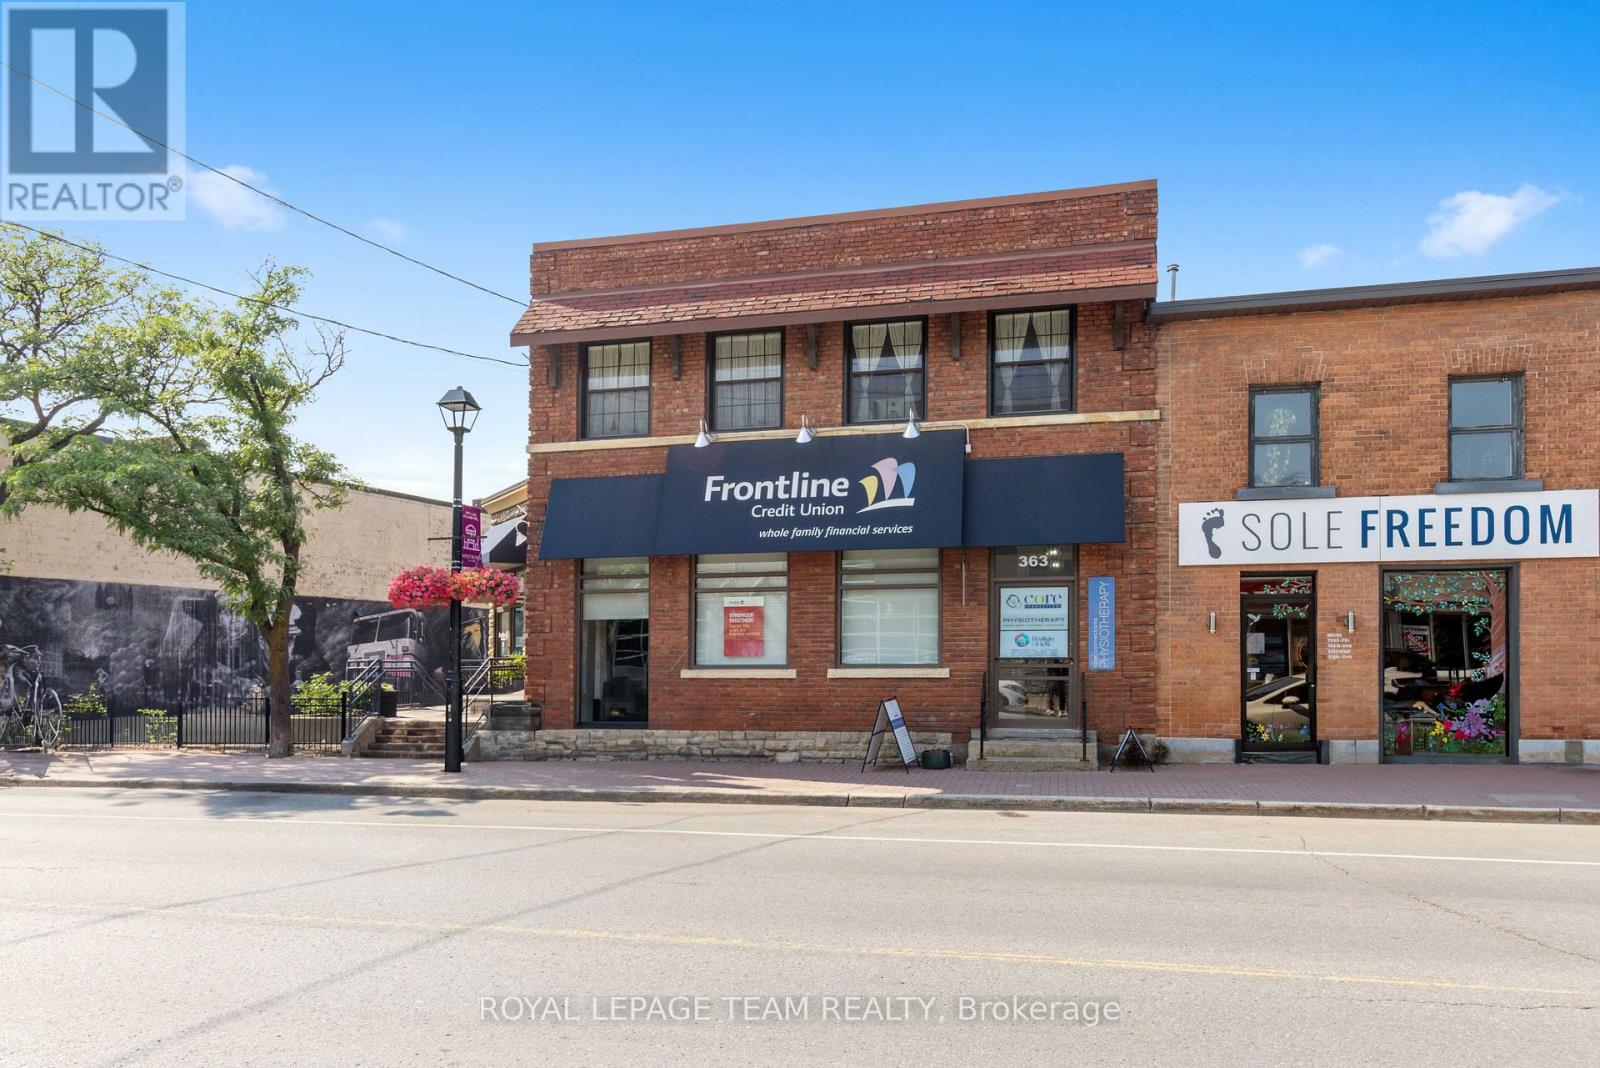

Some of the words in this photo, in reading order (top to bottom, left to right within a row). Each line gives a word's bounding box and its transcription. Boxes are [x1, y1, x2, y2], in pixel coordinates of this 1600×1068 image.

[704, 471, 850, 502] Frontline
[751, 504, 795, 518] Credit
[800, 502, 844, 516] Union
[759, 529, 789, 538] whole
[790, 526, 824, 539] family
[825, 524, 870, 537] financial
[872, 524, 914, 534] services
[1241, 510, 1343, 551] SOLE
[1360, 503, 1573, 549] FREEDOM
[1018, 555, 1049, 567] 363
[1098, 581, 1111, 669] PHYSIOTHERAPY
